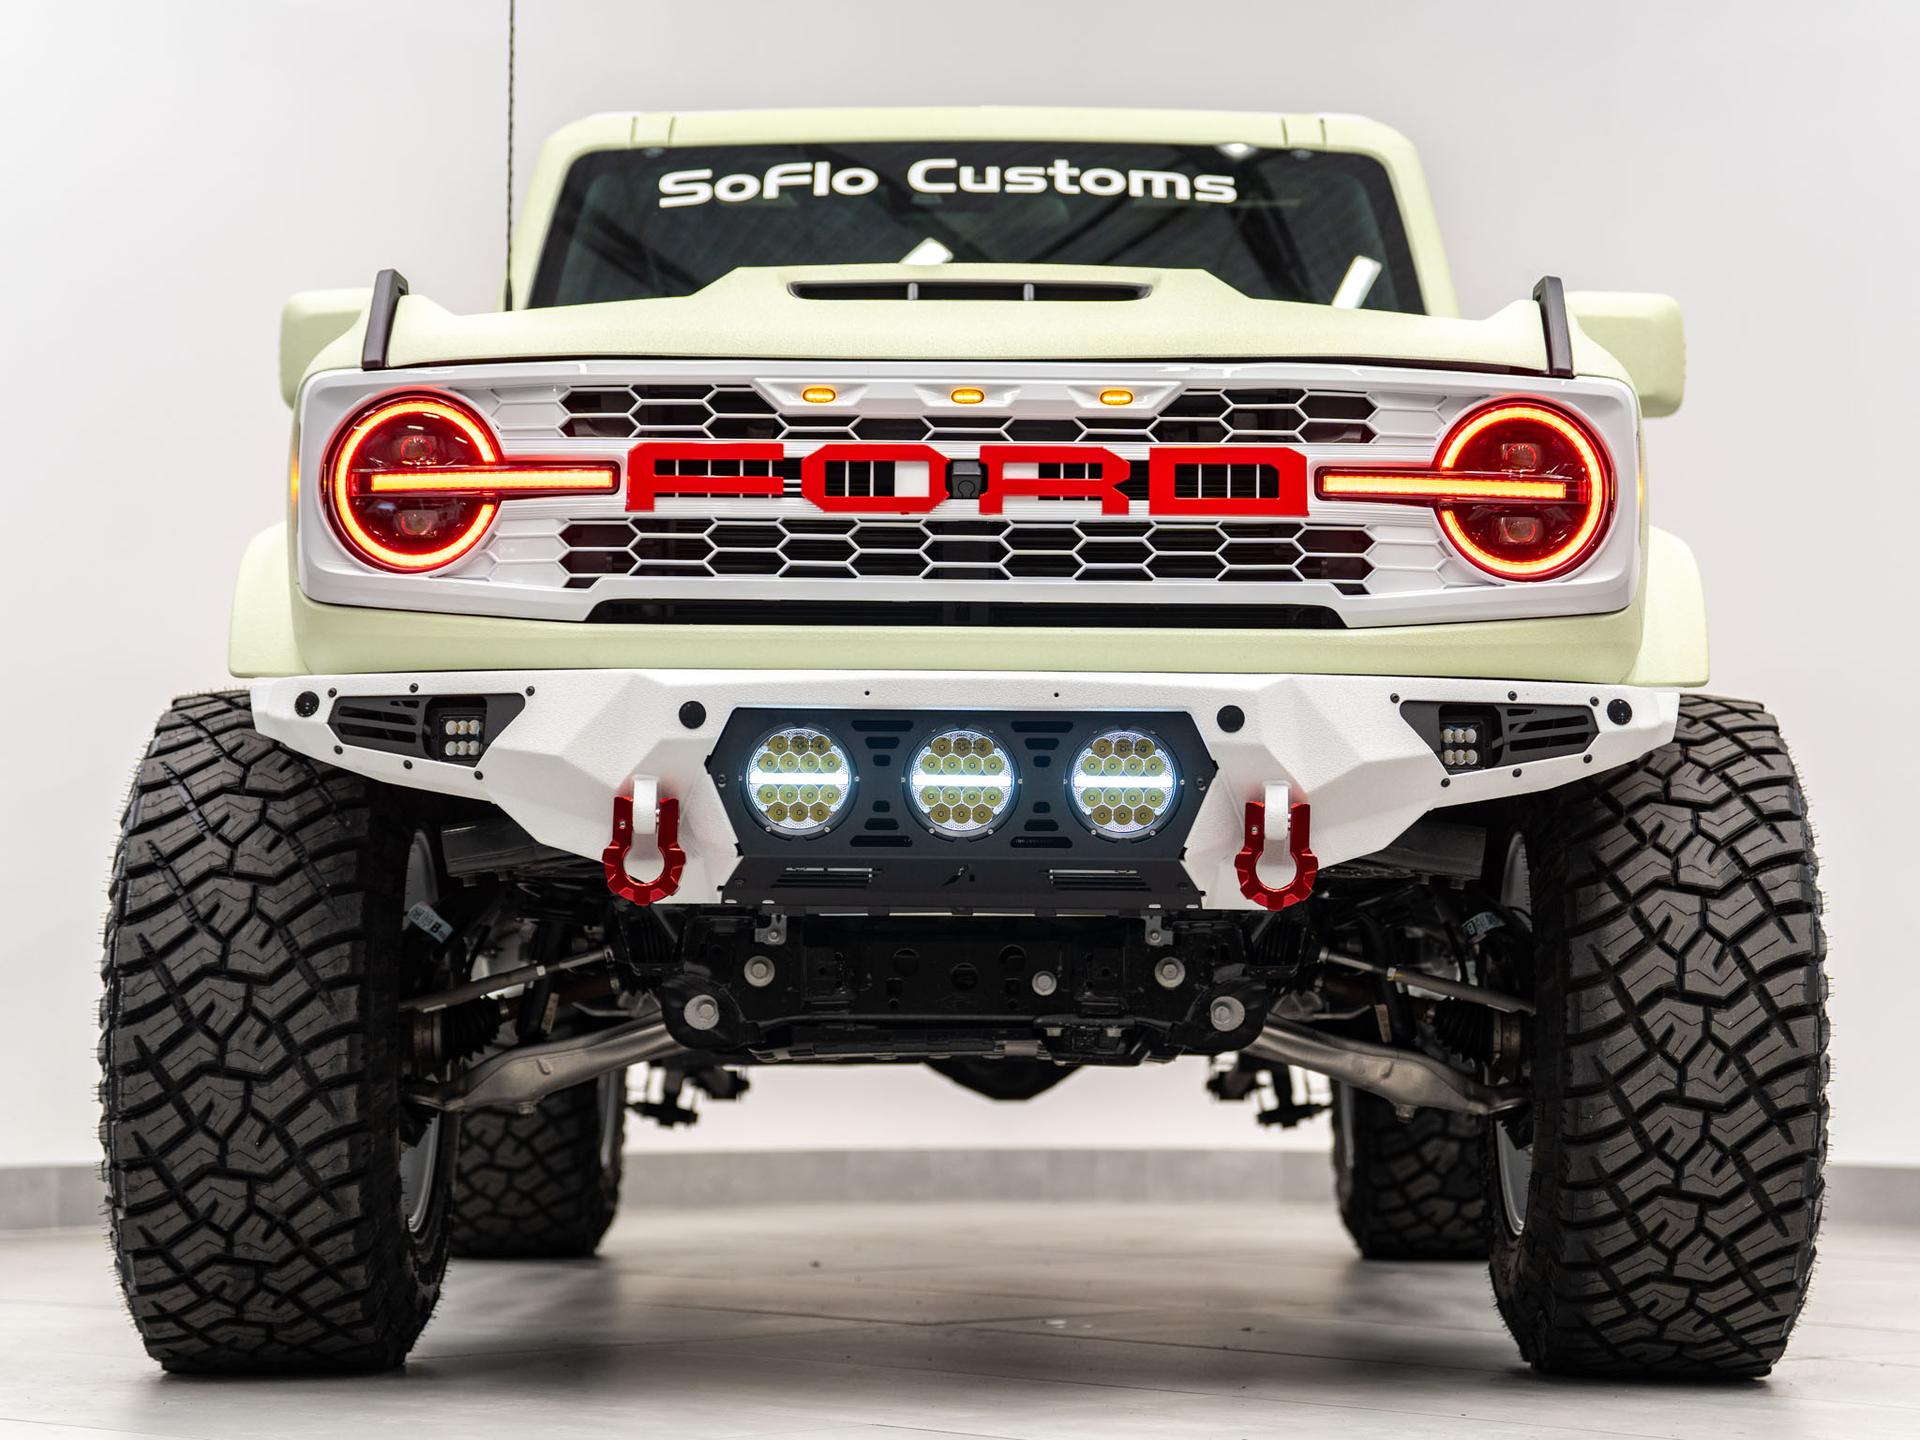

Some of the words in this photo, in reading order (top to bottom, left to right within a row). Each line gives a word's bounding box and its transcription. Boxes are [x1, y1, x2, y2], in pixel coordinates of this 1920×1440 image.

[659, 160, 879, 208] SoFlo
[907, 158, 1237, 203] Customs
[626, 443, 1309, 516] FORD
